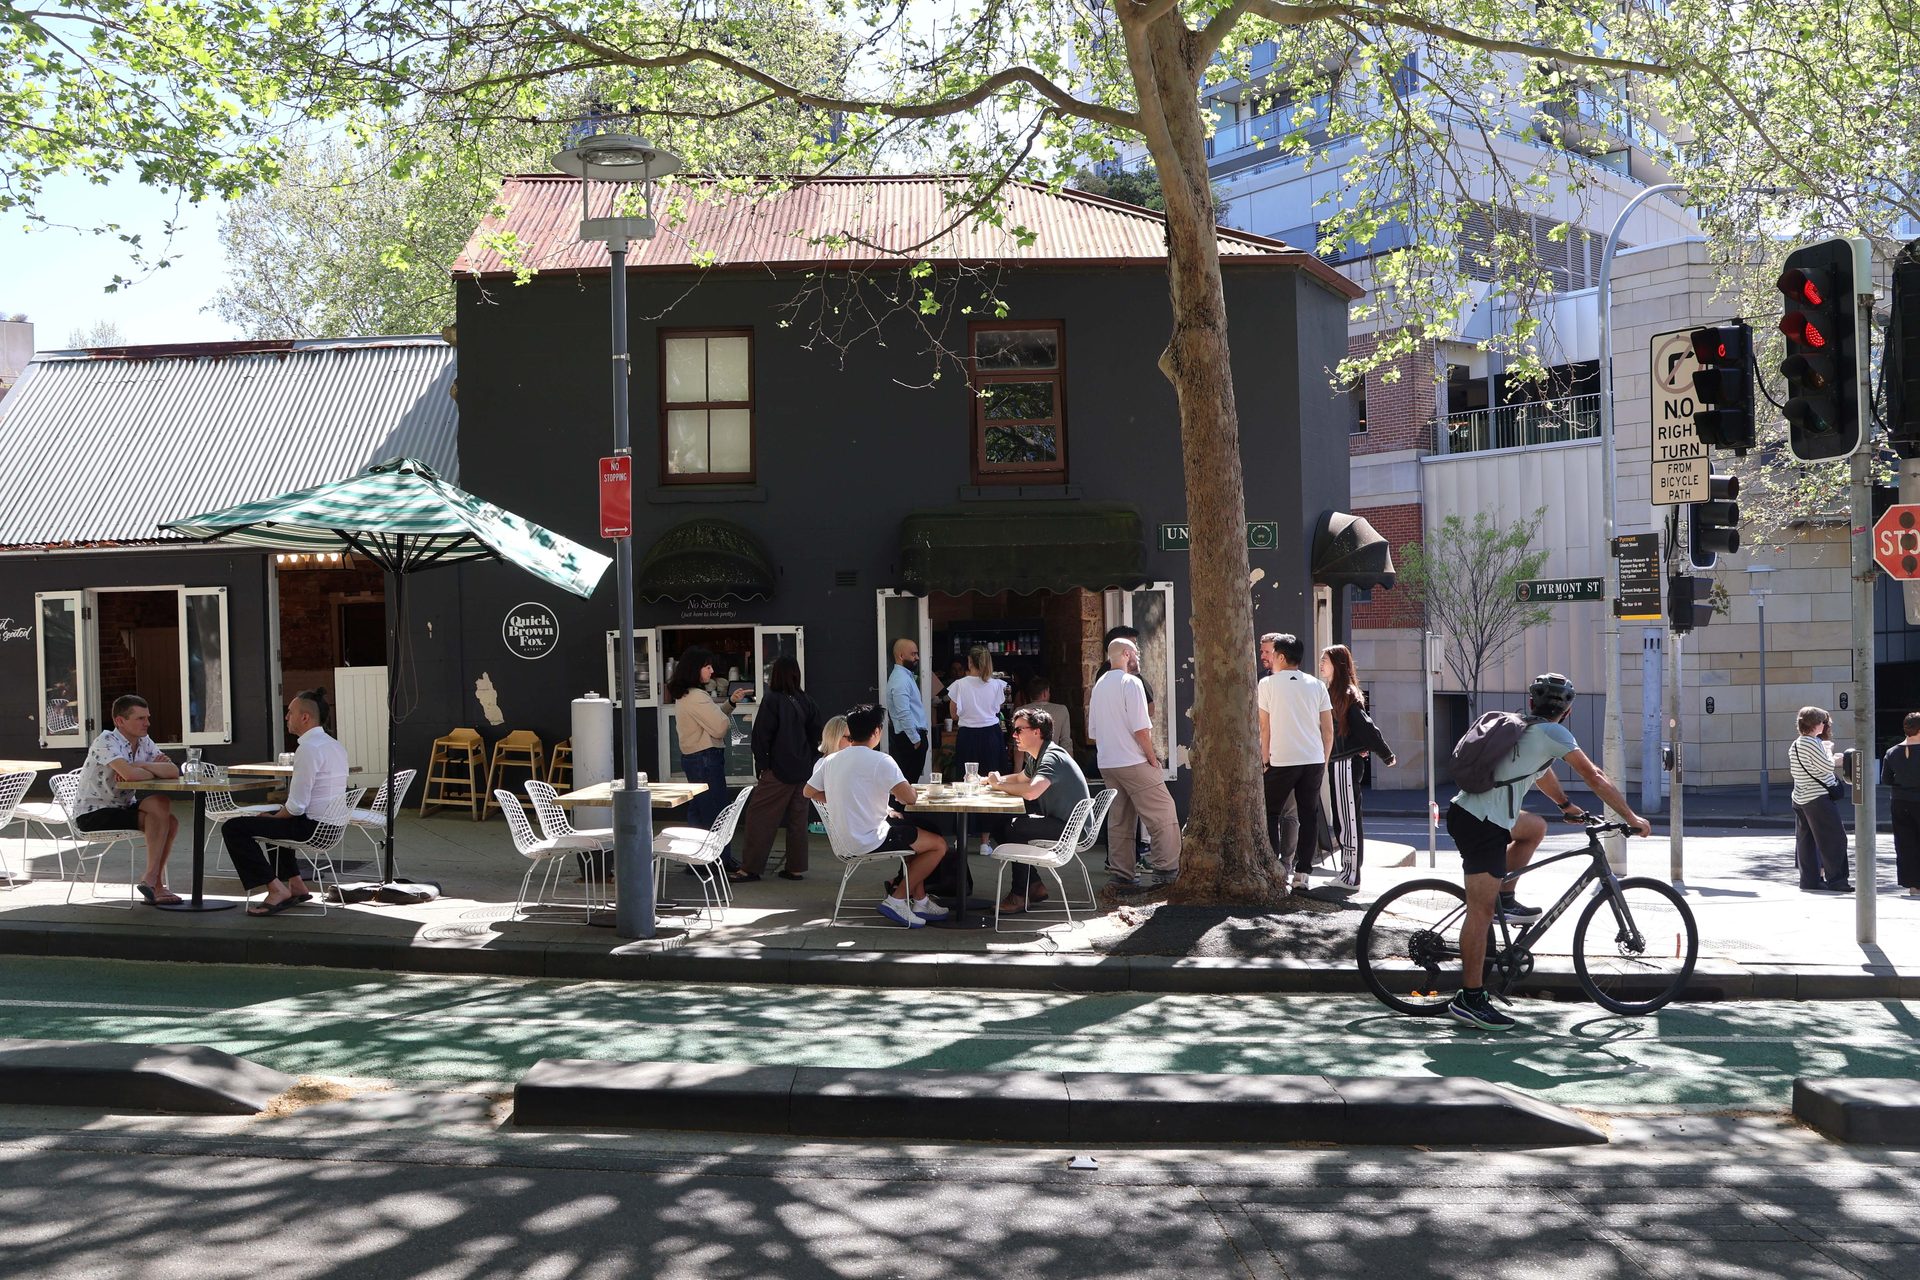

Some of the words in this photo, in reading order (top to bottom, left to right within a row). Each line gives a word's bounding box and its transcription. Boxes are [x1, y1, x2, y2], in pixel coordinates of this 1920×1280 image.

[1665, 397, 1693, 420] NO
[1660, 443, 1700, 459] TURN
[610, 462, 620, 471] NO
[1668, 462, 1692, 474] FROM
[604, 473, 627, 482] STOPPING
[1660, 475, 1699, 488] BICYCLE
[1668, 489, 1691, 500] PATH
[1880, 529, 1920, 556] STO
[1536, 582, 1582, 594] PYRMONT
[1587, 581, 1599, 592] ST
[688, 600, 699, 609] No
[701, 600, 729, 609] Service
[0, 618, 15, 631] it
[510, 614, 551, 628] Quick
[508, 625, 554, 637] Brown
[520, 635, 546, 647] Fox.
[1541, 876, 1590, 929] TREK
